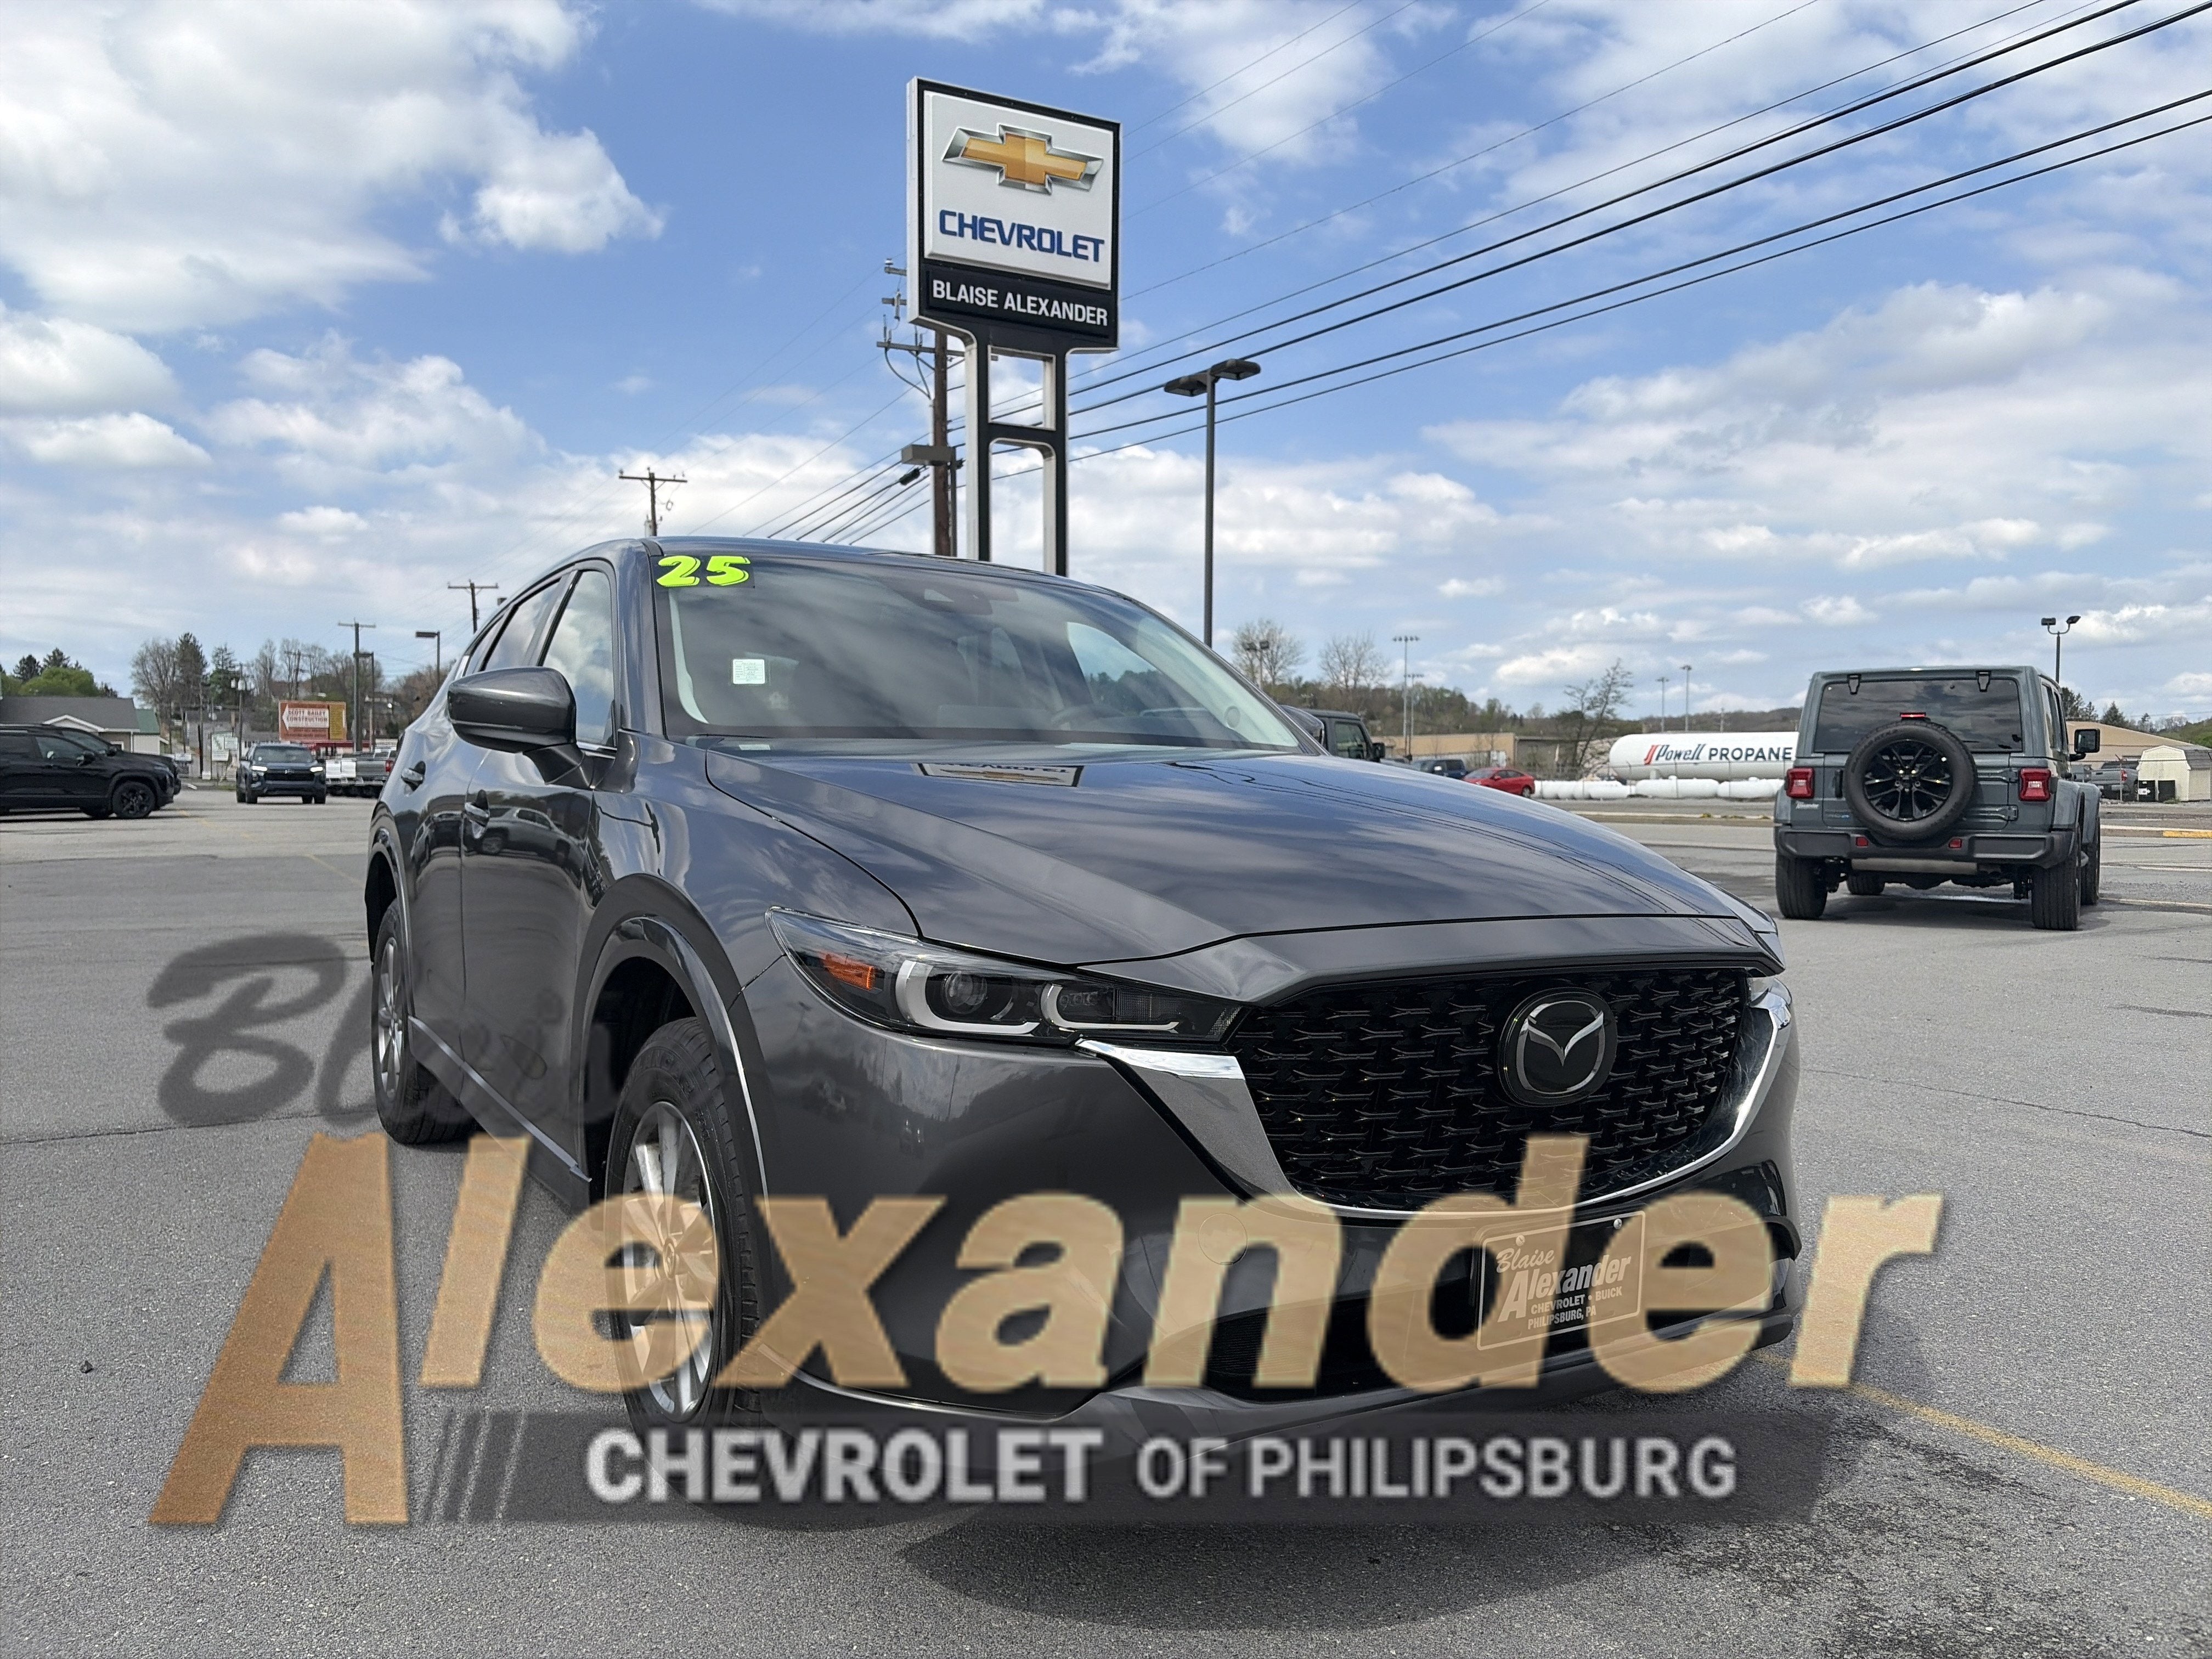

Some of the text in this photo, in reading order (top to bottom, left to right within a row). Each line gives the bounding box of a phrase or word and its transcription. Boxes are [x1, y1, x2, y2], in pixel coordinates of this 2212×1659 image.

[939, 209, 1105, 262] CHEVROLET
[933, 279, 1108, 326] BLAISE ALEXANDER
[657, 555, 751, 587] 25
[1656, 743, 1793, 761] Powell PROPANE
[1496, 1249, 1555, 1273] Blaise
[1497, 1254, 1632, 1323] Alexander
[1531, 1286, 1622, 1315] CHEVROLET BUICK
[1527, 1305, 1597, 1330] PHILIPSBURG, PA
